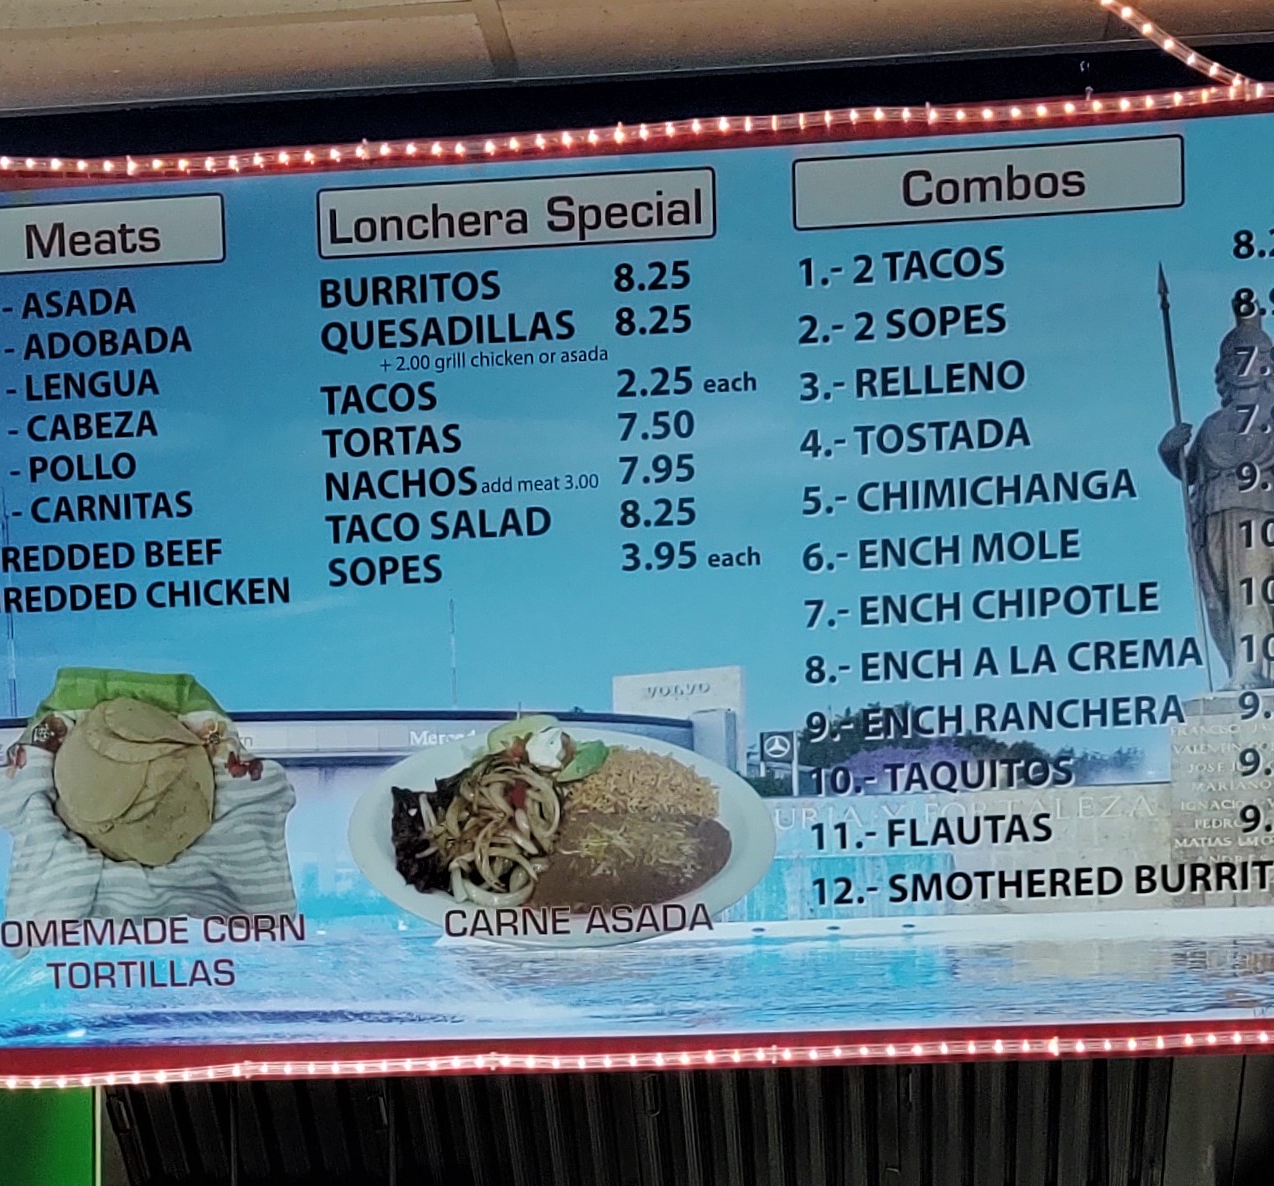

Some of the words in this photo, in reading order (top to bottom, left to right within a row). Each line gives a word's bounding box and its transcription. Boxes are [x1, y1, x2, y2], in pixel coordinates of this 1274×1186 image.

[902, 165, 1086, 207] Combos
[329, 203, 528, 245] Lonchera
[547, 189, 703, 241] Special
[24, 221, 161, 259] Meats
[320, 270, 501, 308] BURRITOS
[614, 261, 691, 292] 8.25
[799, 257, 842, 287] 1.-
[853, 254, 874, 284] 2
[883, 245, 1005, 282] TACOS
[22, 287, 137, 318] ASADA
[23, 327, 192, 361] ADOBADA
[321, 310, 576, 353] QUESADILLAS
[615, 304, 692, 336] 8.25
[396, 355, 430, 372] 2.00
[435, 352, 466, 373] grill
[471, 350, 533, 368] chicken
[539, 350, 557, 364] or
[561, 347, 608, 363] asada
[25, 370, 160, 402] LENGUA
[321, 381, 438, 415] TACOS
[617, 366, 693, 397] 2.25
[703, 372, 757, 393] each
[27, 411, 158, 441] CABEZA
[322, 424, 462, 458] TORTAS
[618, 410, 694, 442] 7.50
[325, 467, 477, 501] NACHOS
[481, 476, 513, 493] add
[517, 475, 560, 491] meat
[565, 473, 599, 490] 3.00
[619, 454, 695, 485] 7.95
[802, 486, 848, 515] 5.-
[857, 468, 1137, 513] CHIMICHANGA
[30, 492, 193, 524] CARNITAS
[326, 514, 420, 545] TACO
[431, 506, 551, 540] SALAD
[620, 497, 696, 528] 8.25
[145, 539, 222, 568] BEEF
[329, 554, 443, 587] SOPES
[621, 541, 697, 572] 3.95
[708, 547, 761, 567] each
[810, 764, 875, 796] 10.-
[884, 756, 1074, 795] TAQUITOS
[812, 876, 879, 906] 12.-
[889, 865, 1123, 904] SMOTHERED
[203, 913, 306, 943] CORN
[46, 959, 235, 990] TORTILLAS
